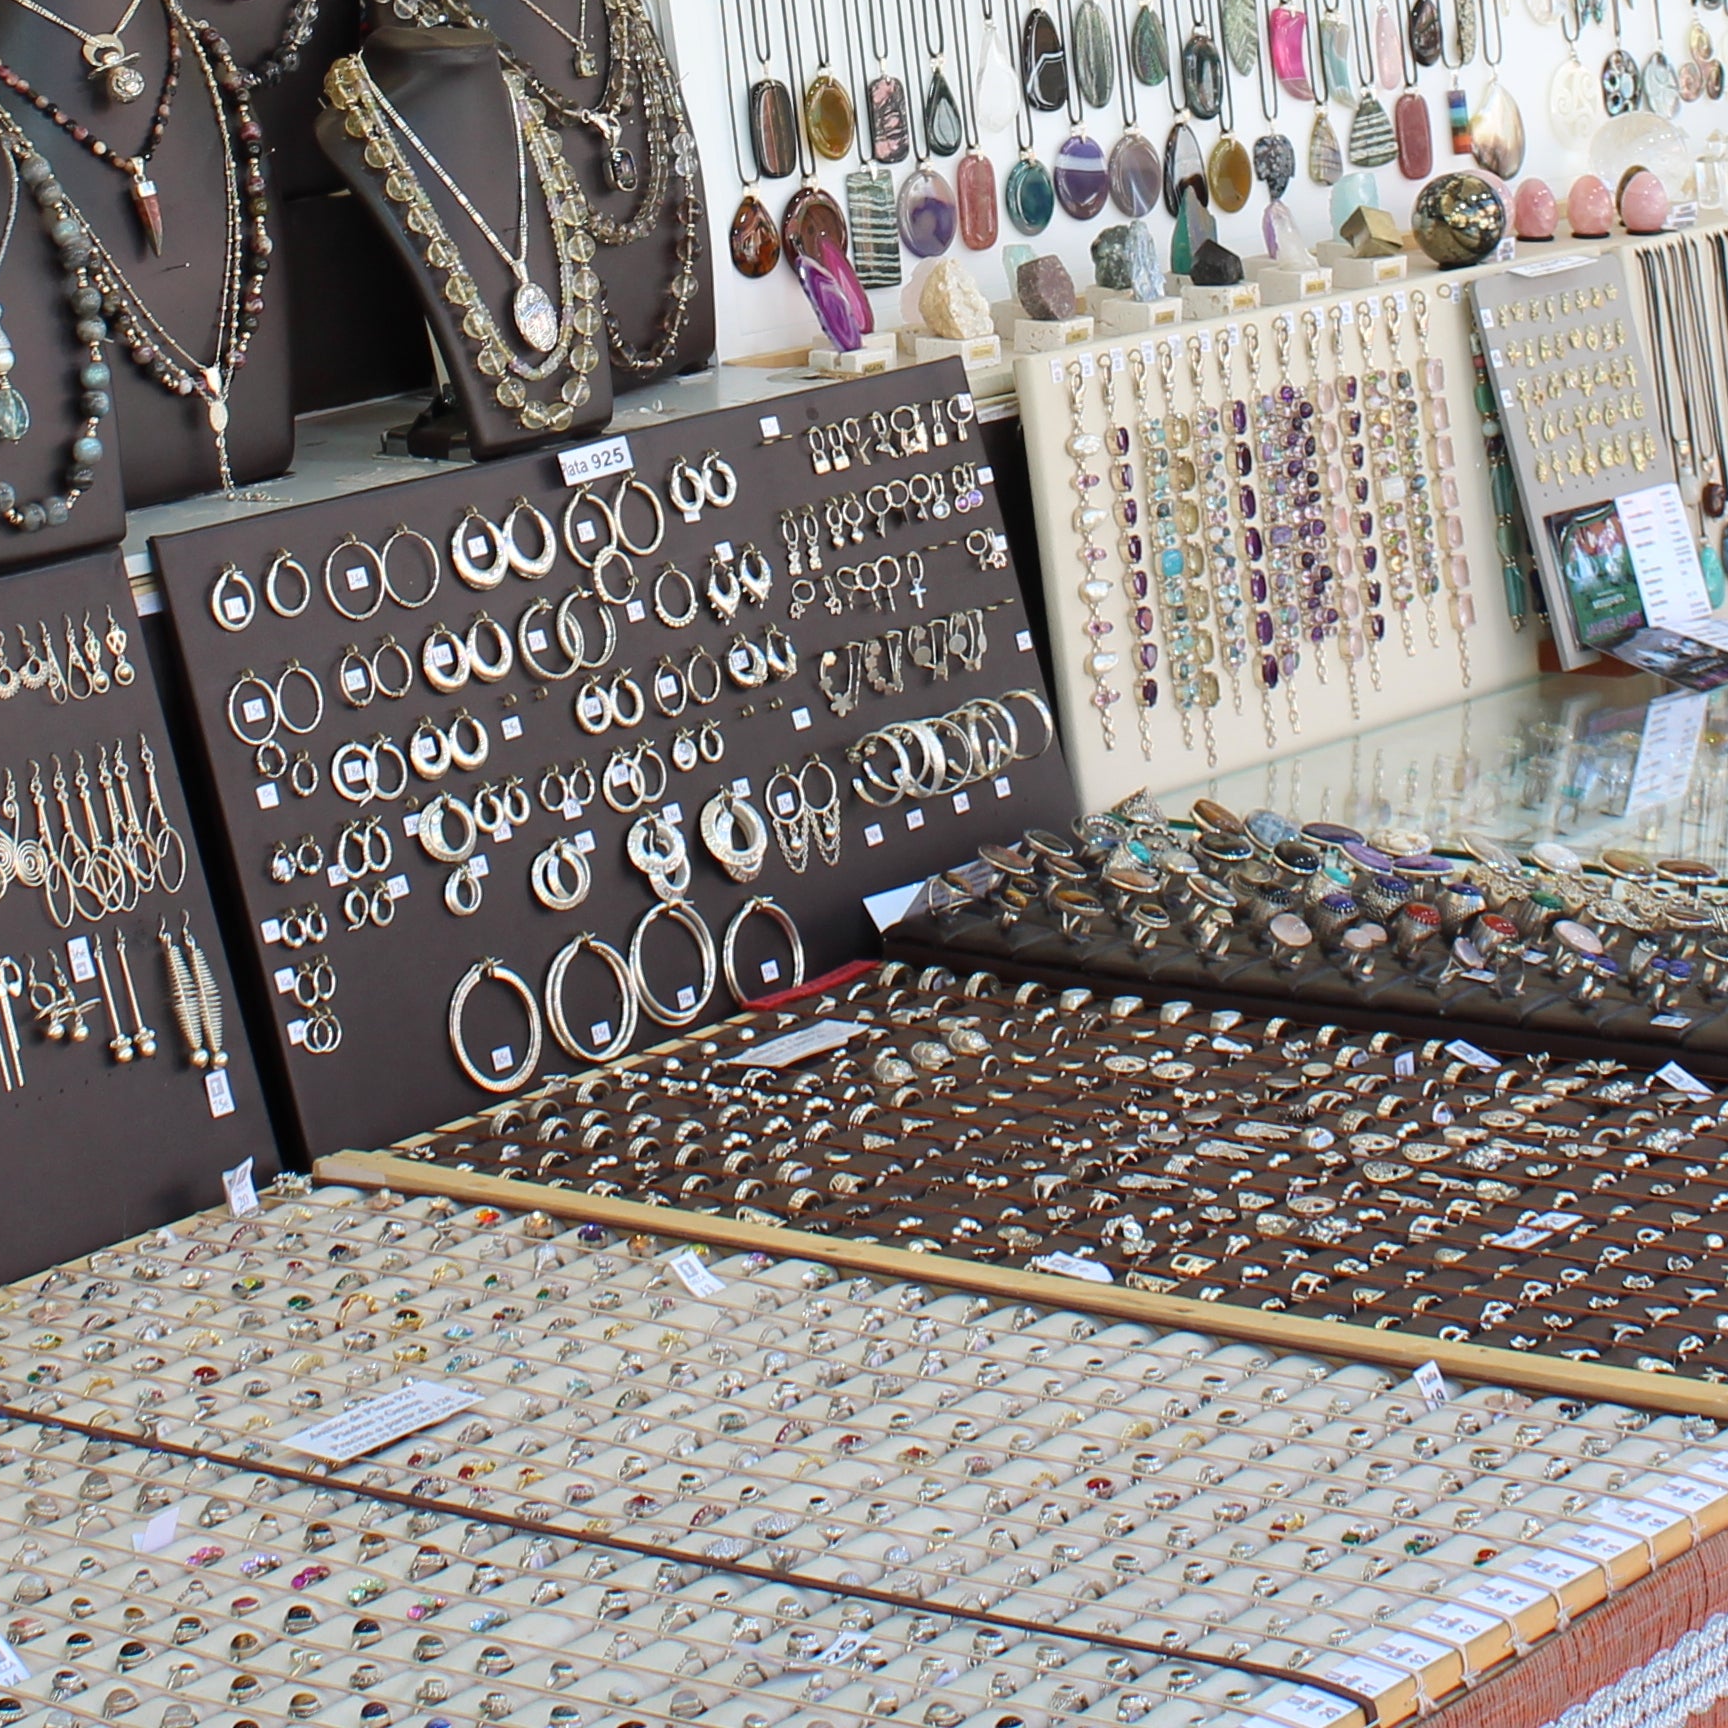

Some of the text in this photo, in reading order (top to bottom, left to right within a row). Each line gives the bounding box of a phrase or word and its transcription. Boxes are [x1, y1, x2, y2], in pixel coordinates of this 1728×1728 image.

[591, 447, 624, 469] 925
[1459, 1624, 1481, 1636] 12
[1408, 1652, 1431, 1665] 12
